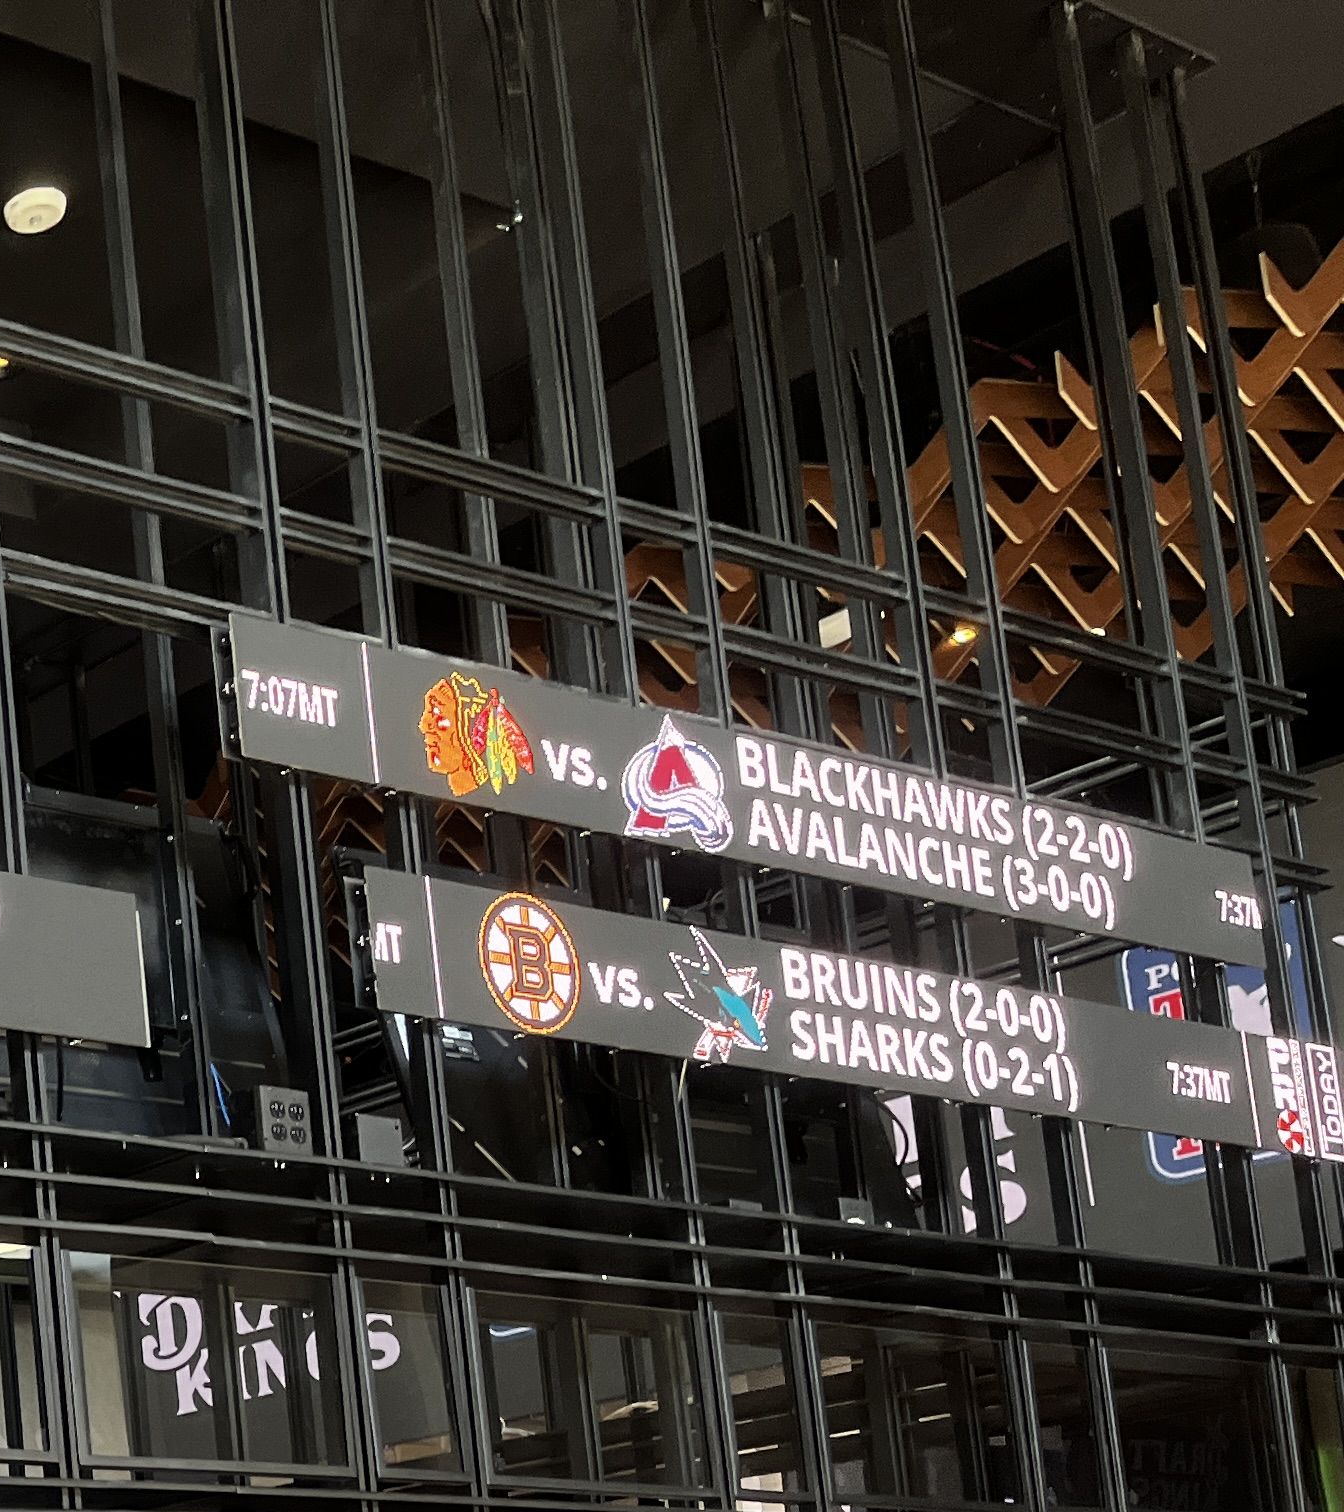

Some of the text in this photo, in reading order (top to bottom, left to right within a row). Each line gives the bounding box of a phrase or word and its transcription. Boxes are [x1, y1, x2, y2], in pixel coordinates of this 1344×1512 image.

[241, 668, 339, 728] 7:07MT
[736, 736, 1134, 883] BLACKHAWKS (2-2-0)
[747, 799, 1116, 931] AVALANCHE (3-0-0)
[780, 947, 941, 1023] BRUINS
[949, 979, 1066, 1054] (2-0-0)
[789, 1009, 1079, 1113] SHARKS (0-2-1)
[1166, 1060, 1232, 1104] 7:37MT
